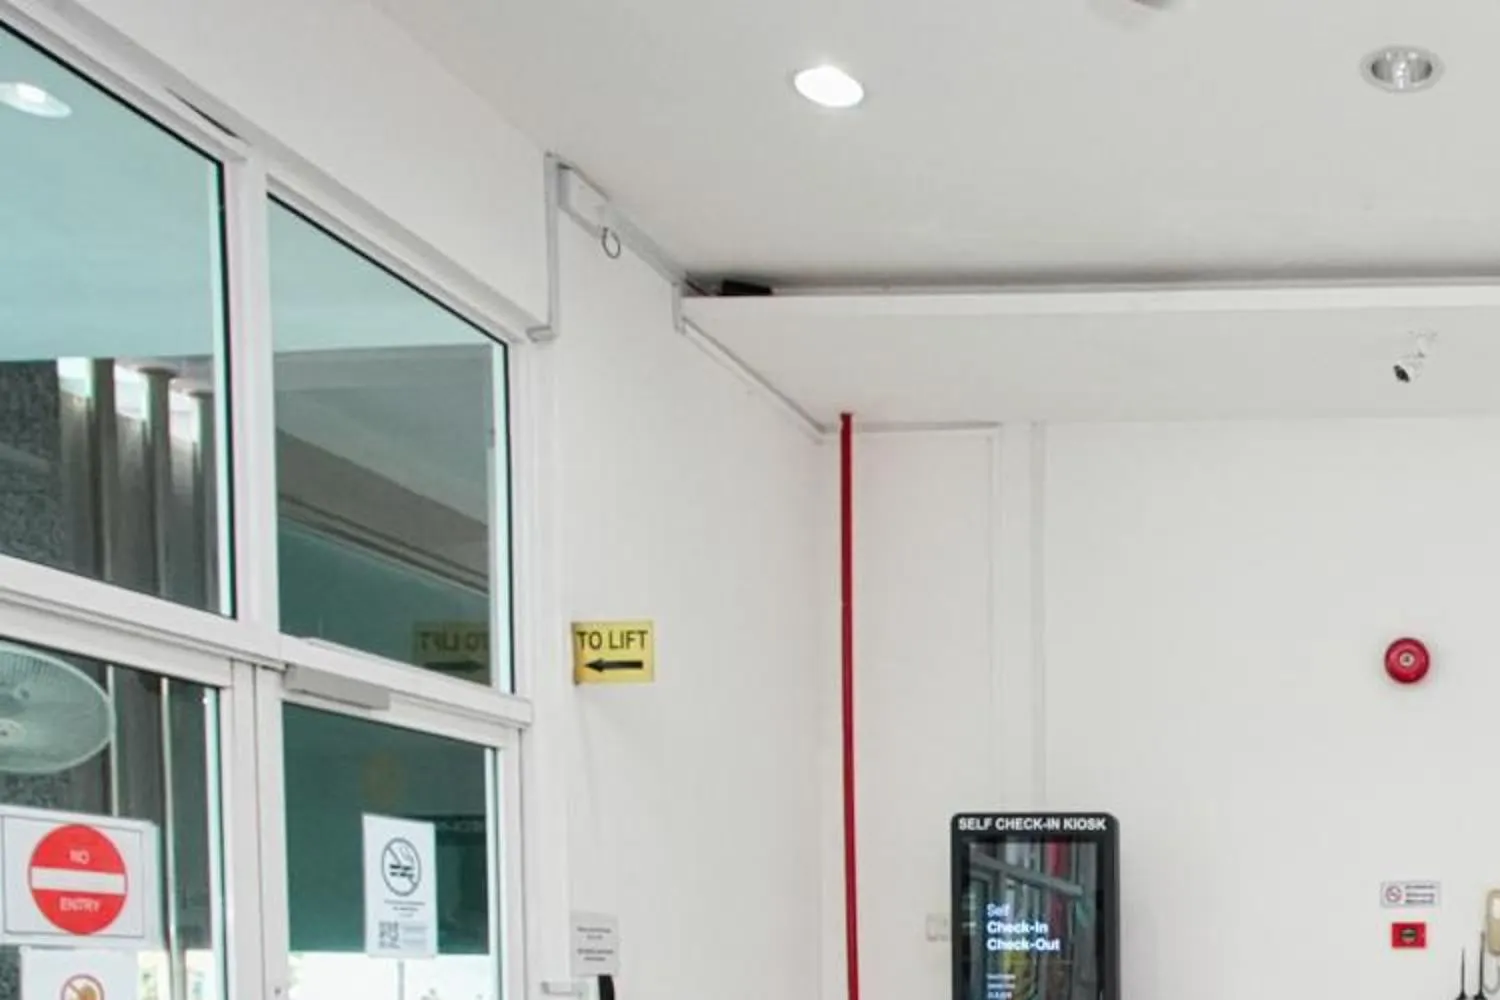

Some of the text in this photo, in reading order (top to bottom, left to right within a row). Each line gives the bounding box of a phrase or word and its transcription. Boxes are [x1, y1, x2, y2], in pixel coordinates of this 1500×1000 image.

[576, 630, 648, 650] TO LIFT
[958, 817, 1107, 831] SELF CHECK-IN KIOSK
[69, 849, 90, 865] NO
[60, 896, 101, 913] ENTRY
[986, 903, 1010, 917] Self
[986, 920, 1049, 934] Check-In
[986, 937, 1061, 951] Check-Out
